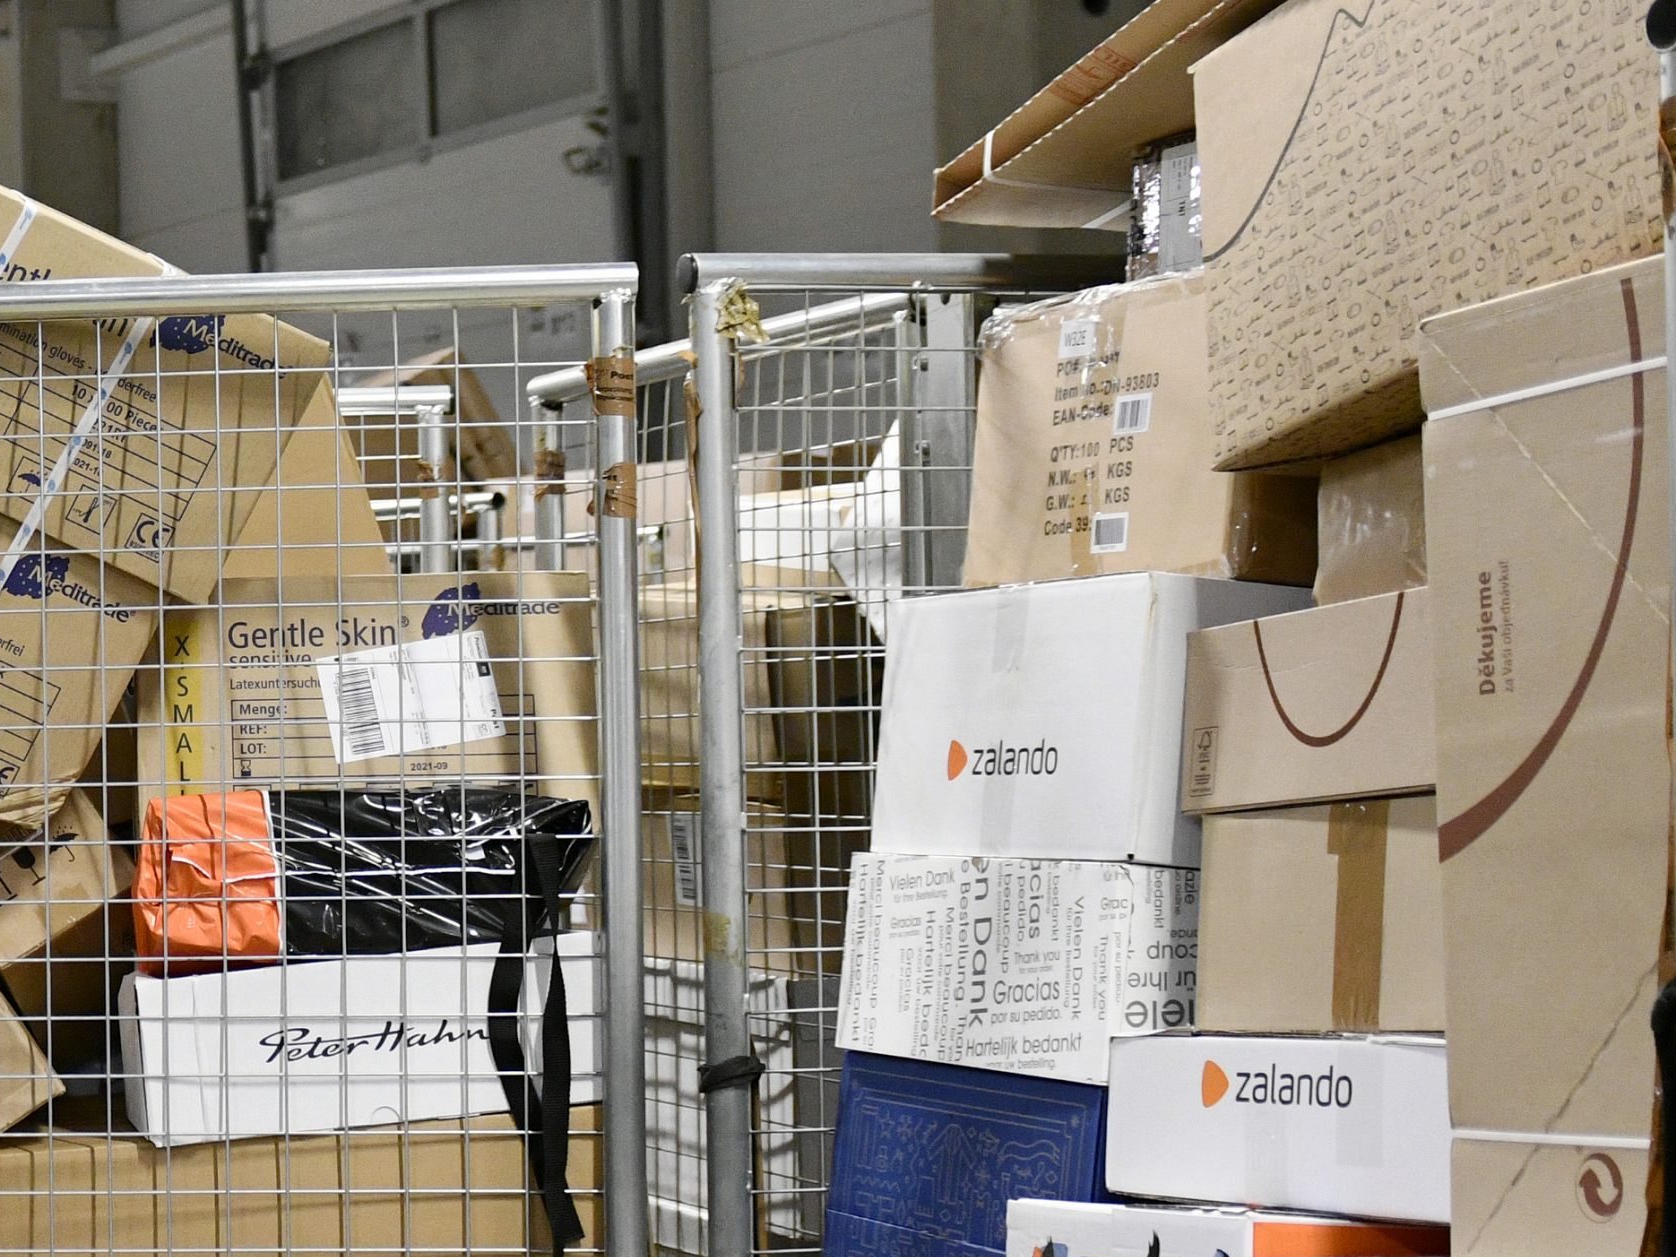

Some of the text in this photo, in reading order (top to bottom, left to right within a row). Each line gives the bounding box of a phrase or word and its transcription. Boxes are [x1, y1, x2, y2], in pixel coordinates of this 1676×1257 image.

[1054, 383, 1078, 401] Item
[1109, 436, 1135, 454] PCS
[1106, 460, 1133, 479] KGS
[1104, 486, 1131, 504] KGS
[27, 563, 136, 625] Meditrade
[228, 620, 325, 650] Gentle
[1477, 570, 1498, 696] Děkujeme
[229, 649, 312, 669] sensitive
[239, 703, 288, 719] Menge:
[240, 741, 267, 756] LOT:
[972, 738, 1058, 778] zalando
[410, 760, 449, 772] 2021-09
[889, 868, 956, 891] Vielen Dank
[870, 859, 885, 1009] Merci beaucoup
[1000, 873, 1013, 974] beaucoup
[922, 910, 936, 996] Hartelijk
[1071, 896, 1084, 1021] Vielen Dank
[1098, 934, 1109, 985] Thank
[937, 906, 956, 1061] Merci beaucoup
[968, 917, 993, 1029] Dank
[1127, 970, 1168, 991] Ihre
[993, 977, 1061, 1005] Gracias
[1010, 1011, 1021, 1023] su
[260, 1019, 492, 1064] Peter Hahn
[966, 1032, 1082, 1060] Hartelijk bedankt
[1235, 1061, 1354, 1110] zalando
